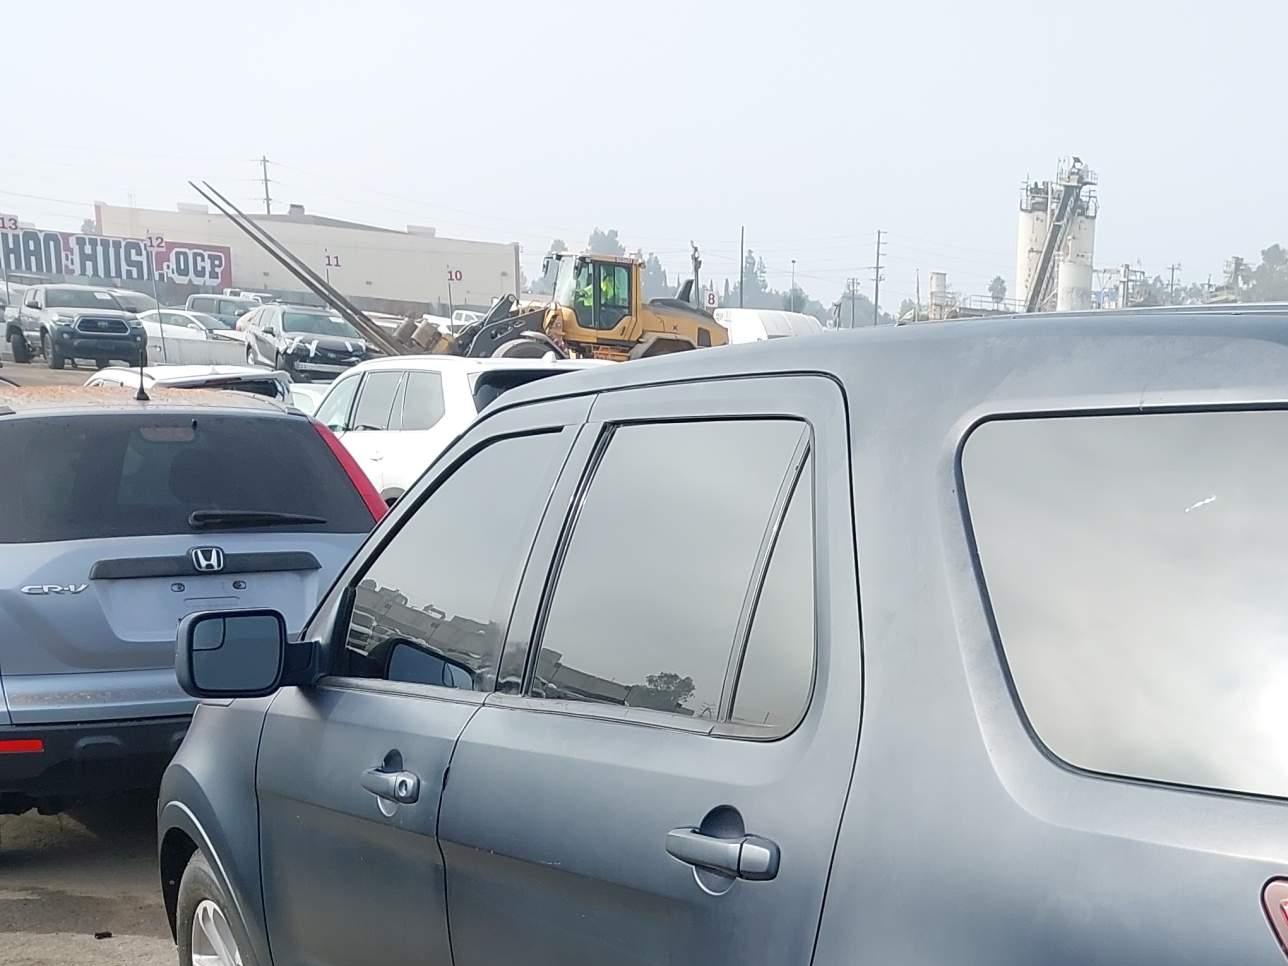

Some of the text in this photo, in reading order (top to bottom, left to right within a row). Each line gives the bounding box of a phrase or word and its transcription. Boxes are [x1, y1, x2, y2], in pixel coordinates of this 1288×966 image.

[147, 236, 164, 248] 12
[325, 255, 341, 267] 11
[447, 270, 463, 282] 10
[707, 292, 715, 305] 8
[20, 583, 90, 596] CR-V
